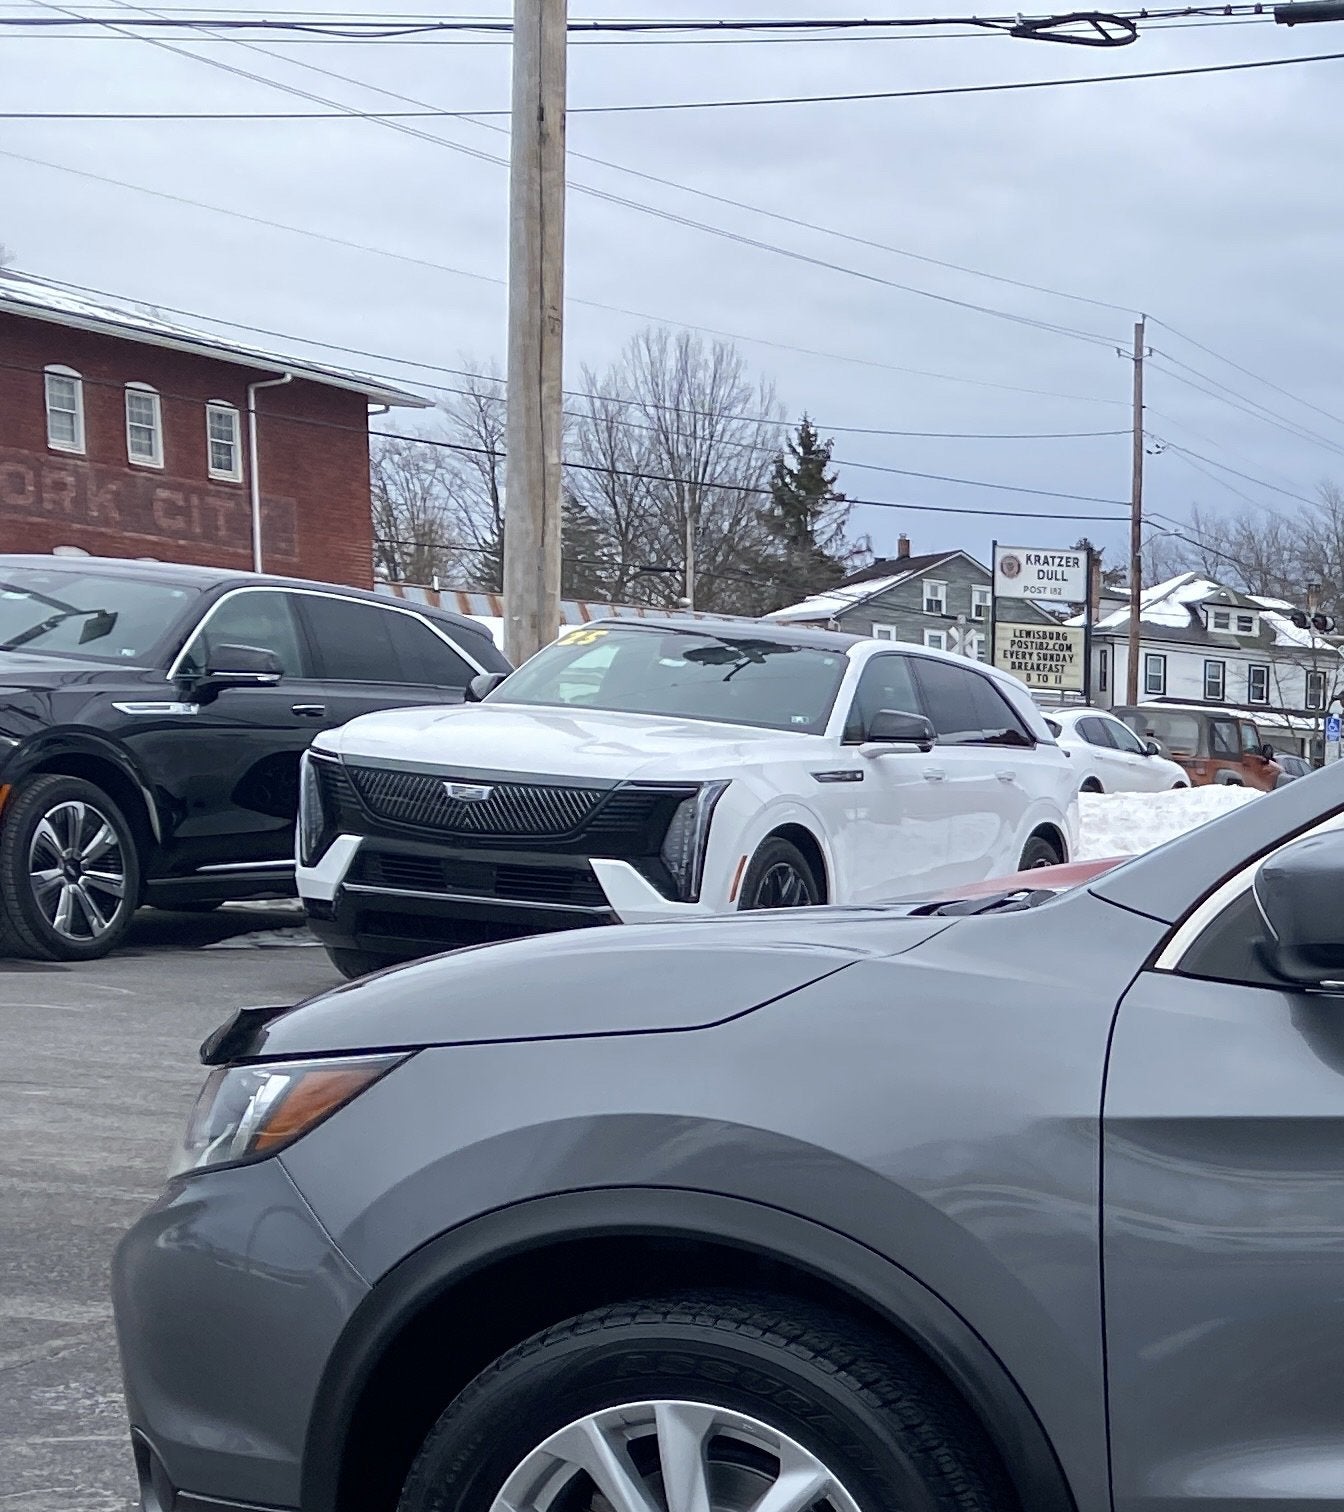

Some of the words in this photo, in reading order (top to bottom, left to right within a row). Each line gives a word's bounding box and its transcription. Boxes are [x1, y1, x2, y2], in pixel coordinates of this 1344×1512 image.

[1025, 553, 1080, 569] KRATZER
[1037, 569, 1068, 582] DULL
[1023, 585, 1047, 594] POST
[1049, 587, 1062, 596] 182
[1013, 628, 1068, 642] LEWISBURG
[1010, 639, 1073, 653] POST182.COM
[1003, 649, 1034, 660] EVERY
[1036, 651, 1074, 664] SUNDAY
[1010, 660, 1066, 674] BREAKFAST
[1026, 672, 1032, 682] 8
[1037, 673, 1049, 683] TO
[1054, 674, 1062, 685] 11
